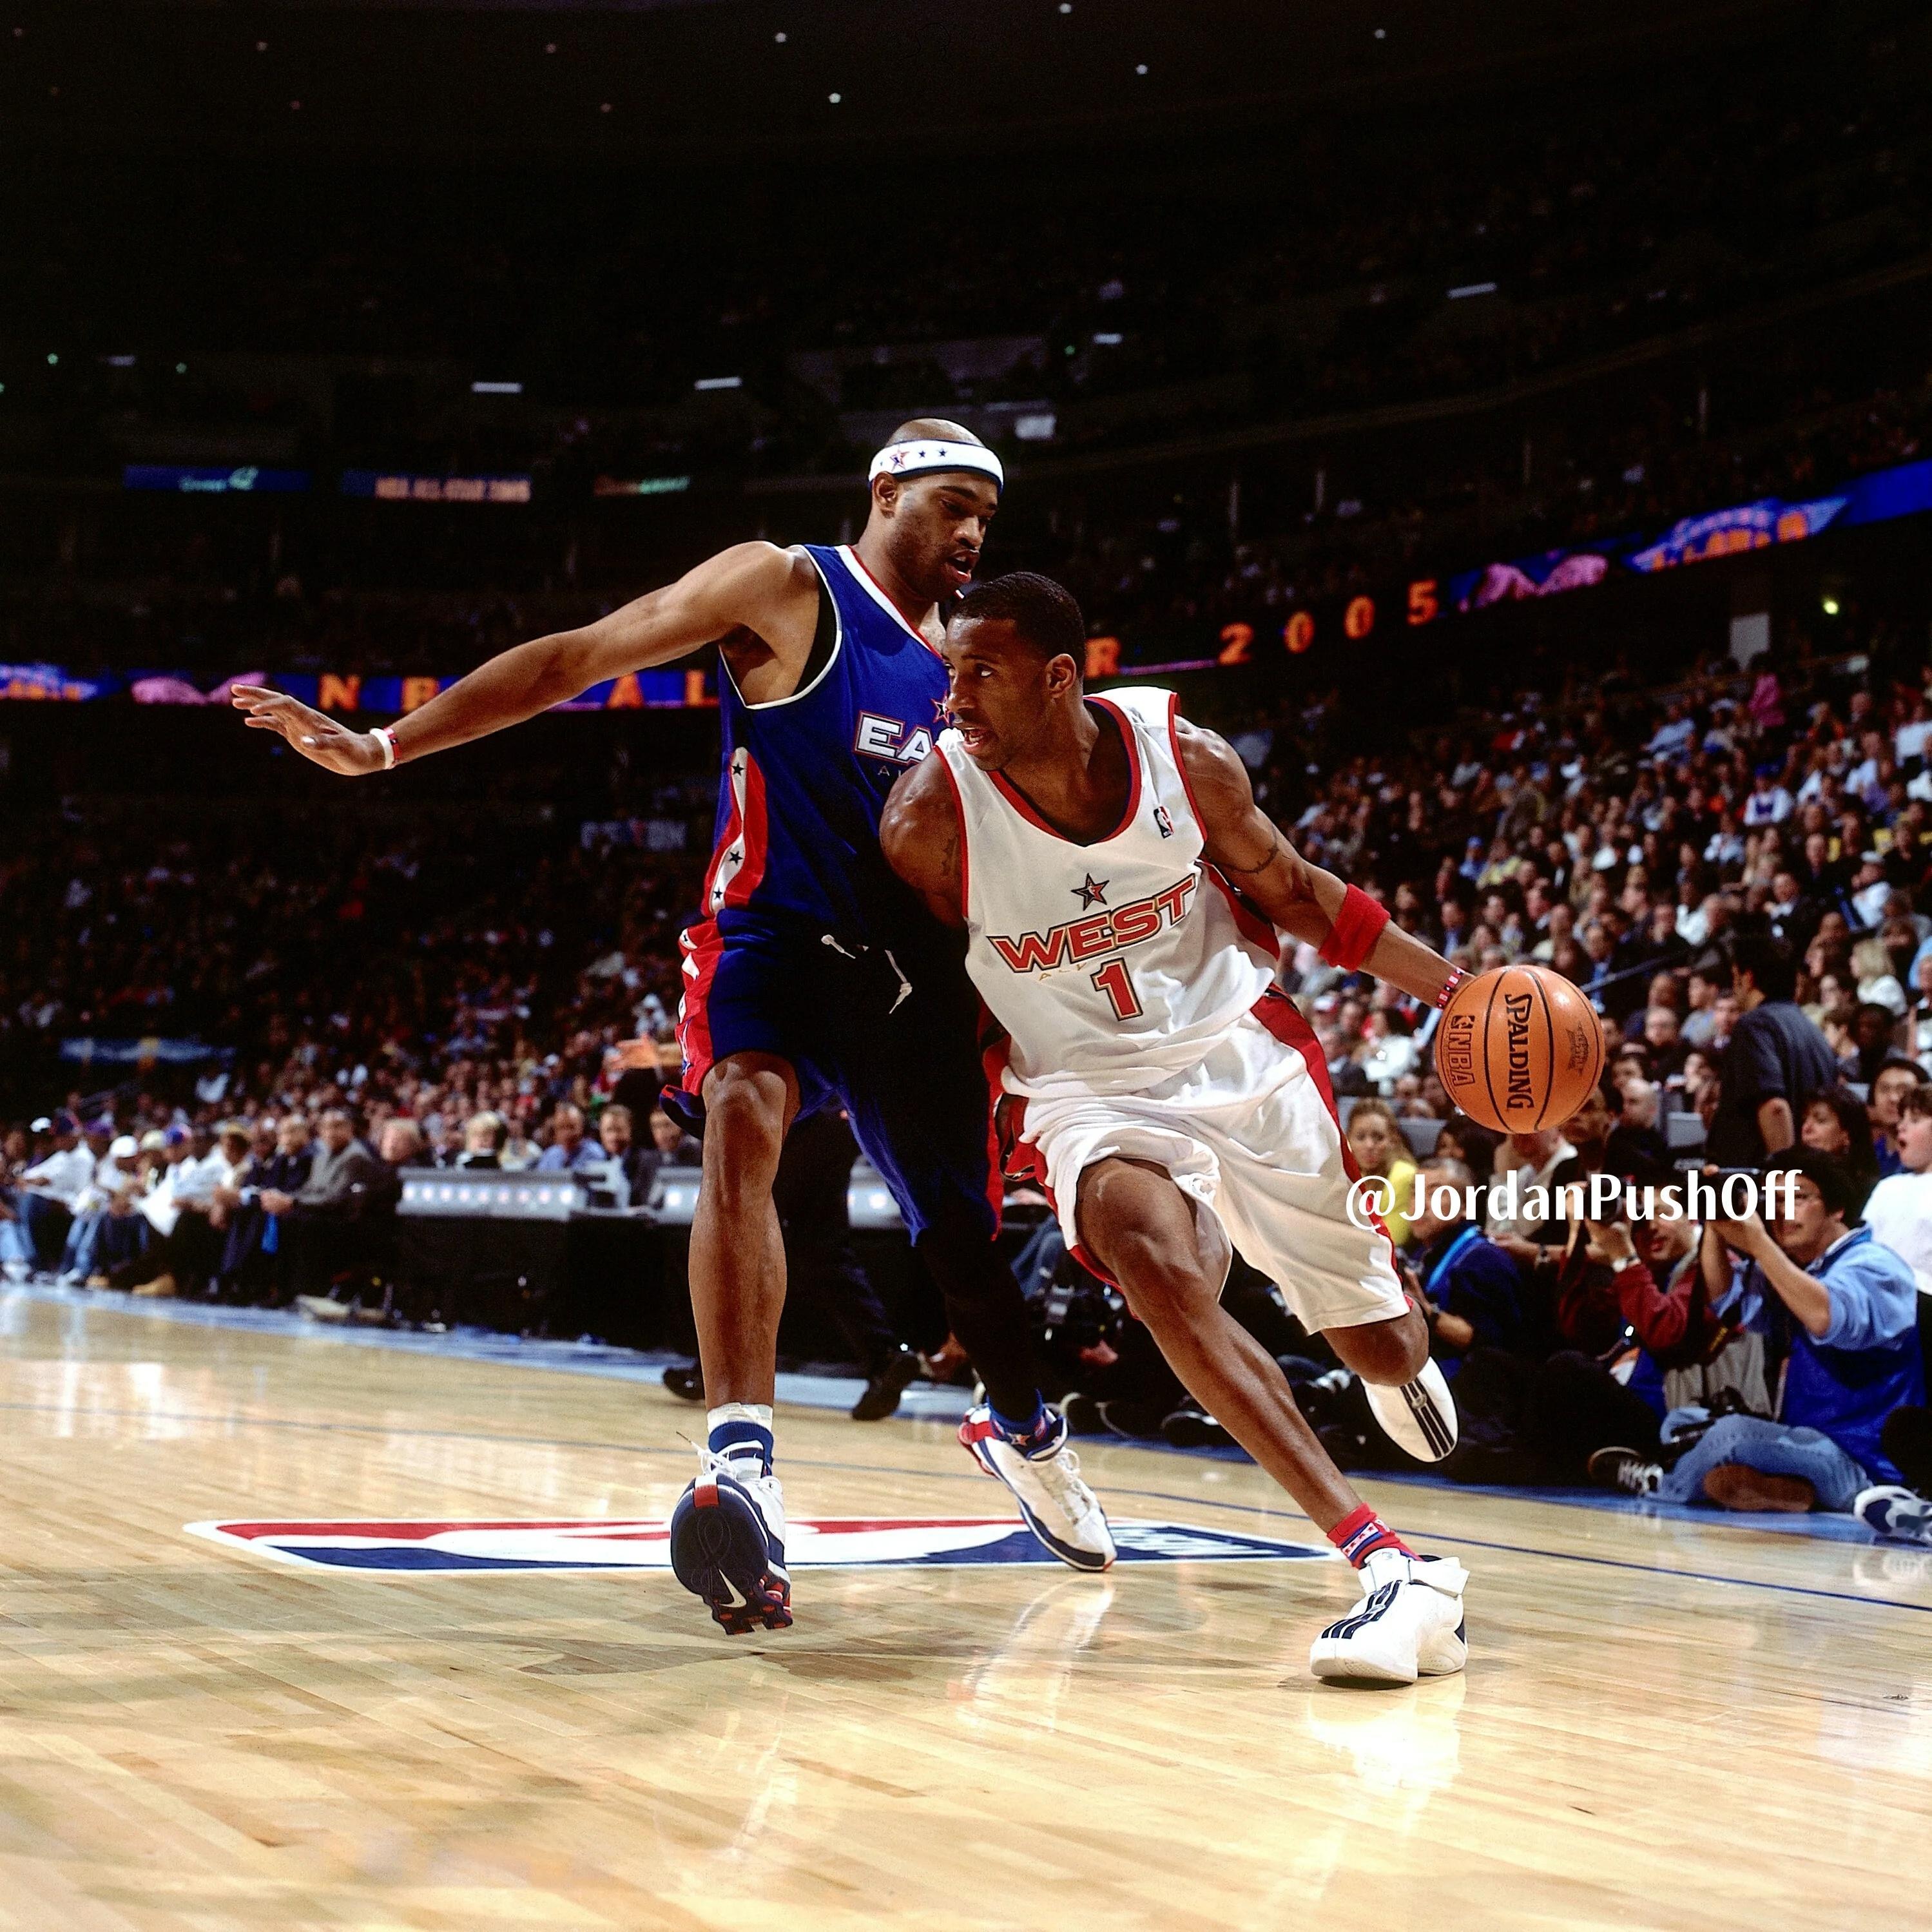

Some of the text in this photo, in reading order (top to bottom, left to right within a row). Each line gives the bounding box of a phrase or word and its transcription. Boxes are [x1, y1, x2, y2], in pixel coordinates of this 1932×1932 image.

[1219, 579, 1439, 666] 2005
[851, 710, 934, 768] EA
[987, 873, 1197, 973] WEST
[1090, 957, 1143, 1021] 1
[1447, 1032, 1476, 1087] NBA
[1504, 993, 1534, 1110] SPALDING
